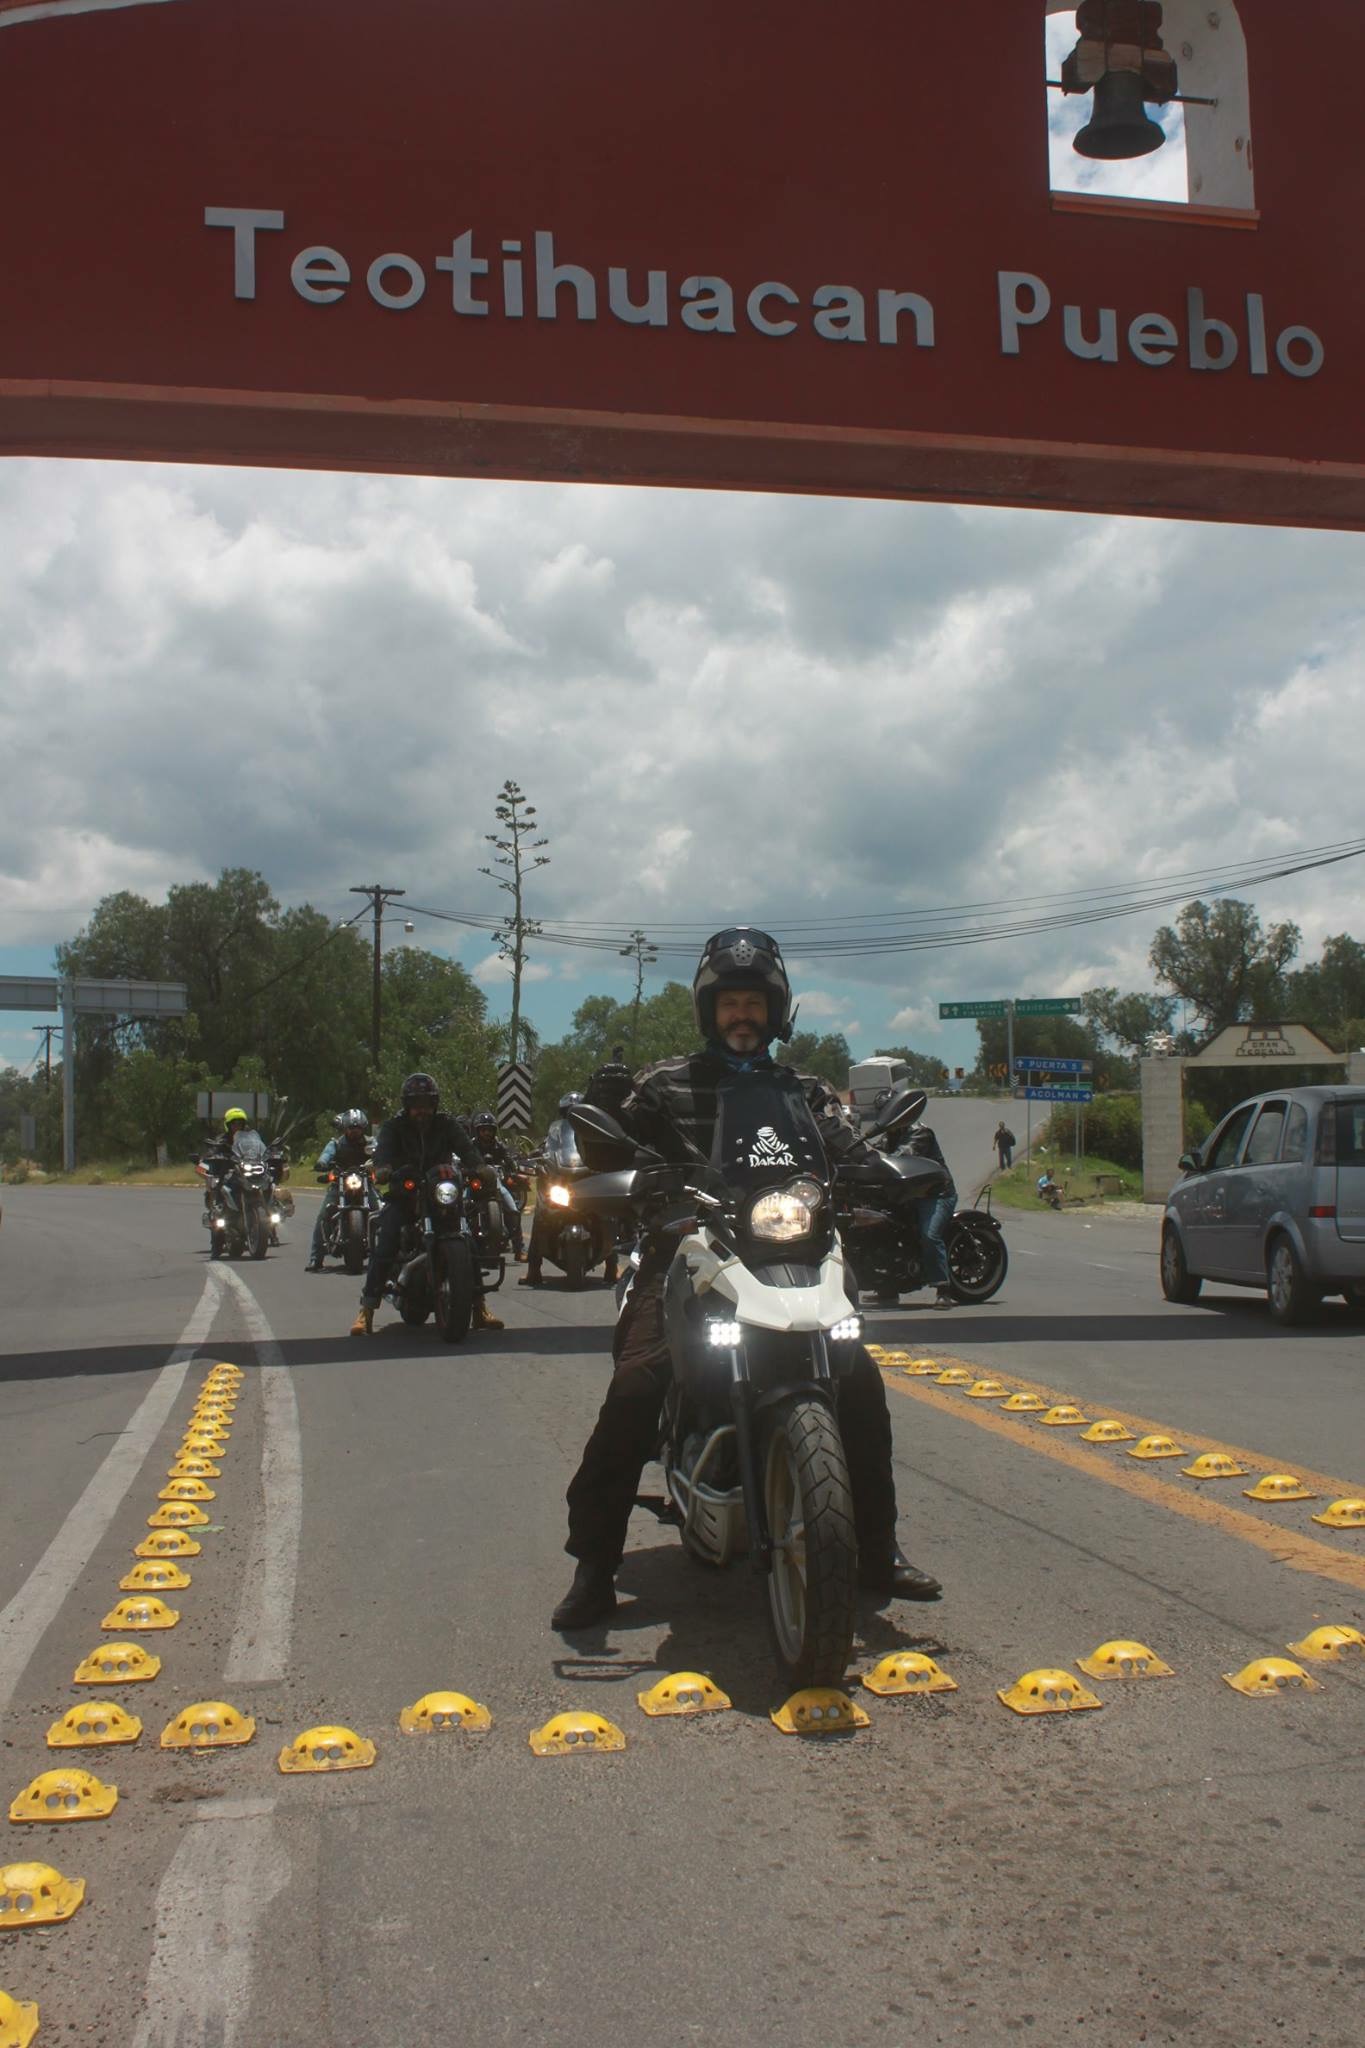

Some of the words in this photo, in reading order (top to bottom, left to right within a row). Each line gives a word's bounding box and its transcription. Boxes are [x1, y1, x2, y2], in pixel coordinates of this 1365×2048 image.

[204, 206, 937, 348] Teotihuacan
[998, 271, 1326, 378] Pueblo
[1028, 1060, 1067, 1070] PUERTA
[1030, 1090, 1080, 1099] ACOLMAN
[748, 1152, 798, 1168] DAKAR
